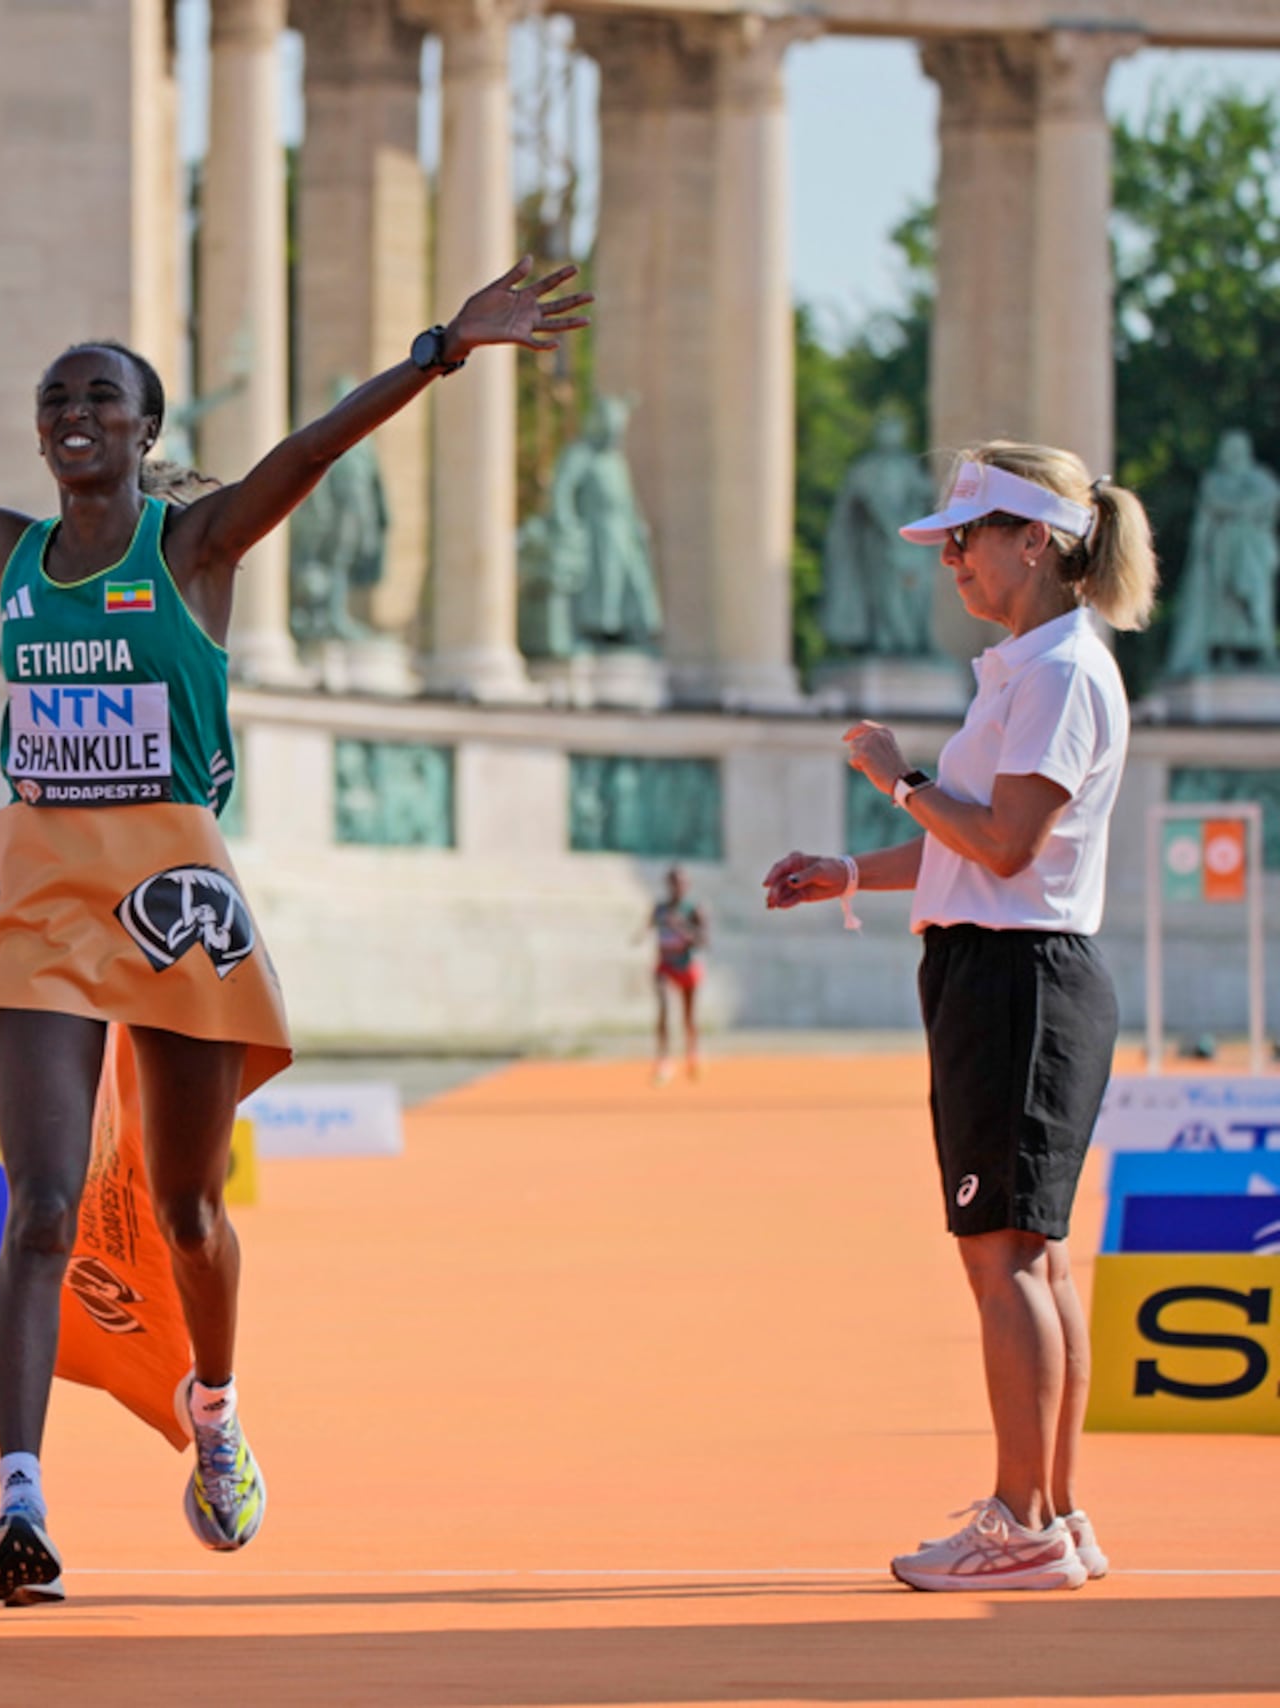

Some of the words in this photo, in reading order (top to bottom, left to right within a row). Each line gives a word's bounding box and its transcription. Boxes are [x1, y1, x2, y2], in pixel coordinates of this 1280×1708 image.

[16, 639, 134, 677] ETHIOPIA
[29, 688, 134, 729] NTN
[15, 733, 160, 773] SHANKULE
[46, 783, 136, 800] BUDAPEST
[140, 783, 161, 798] 23
